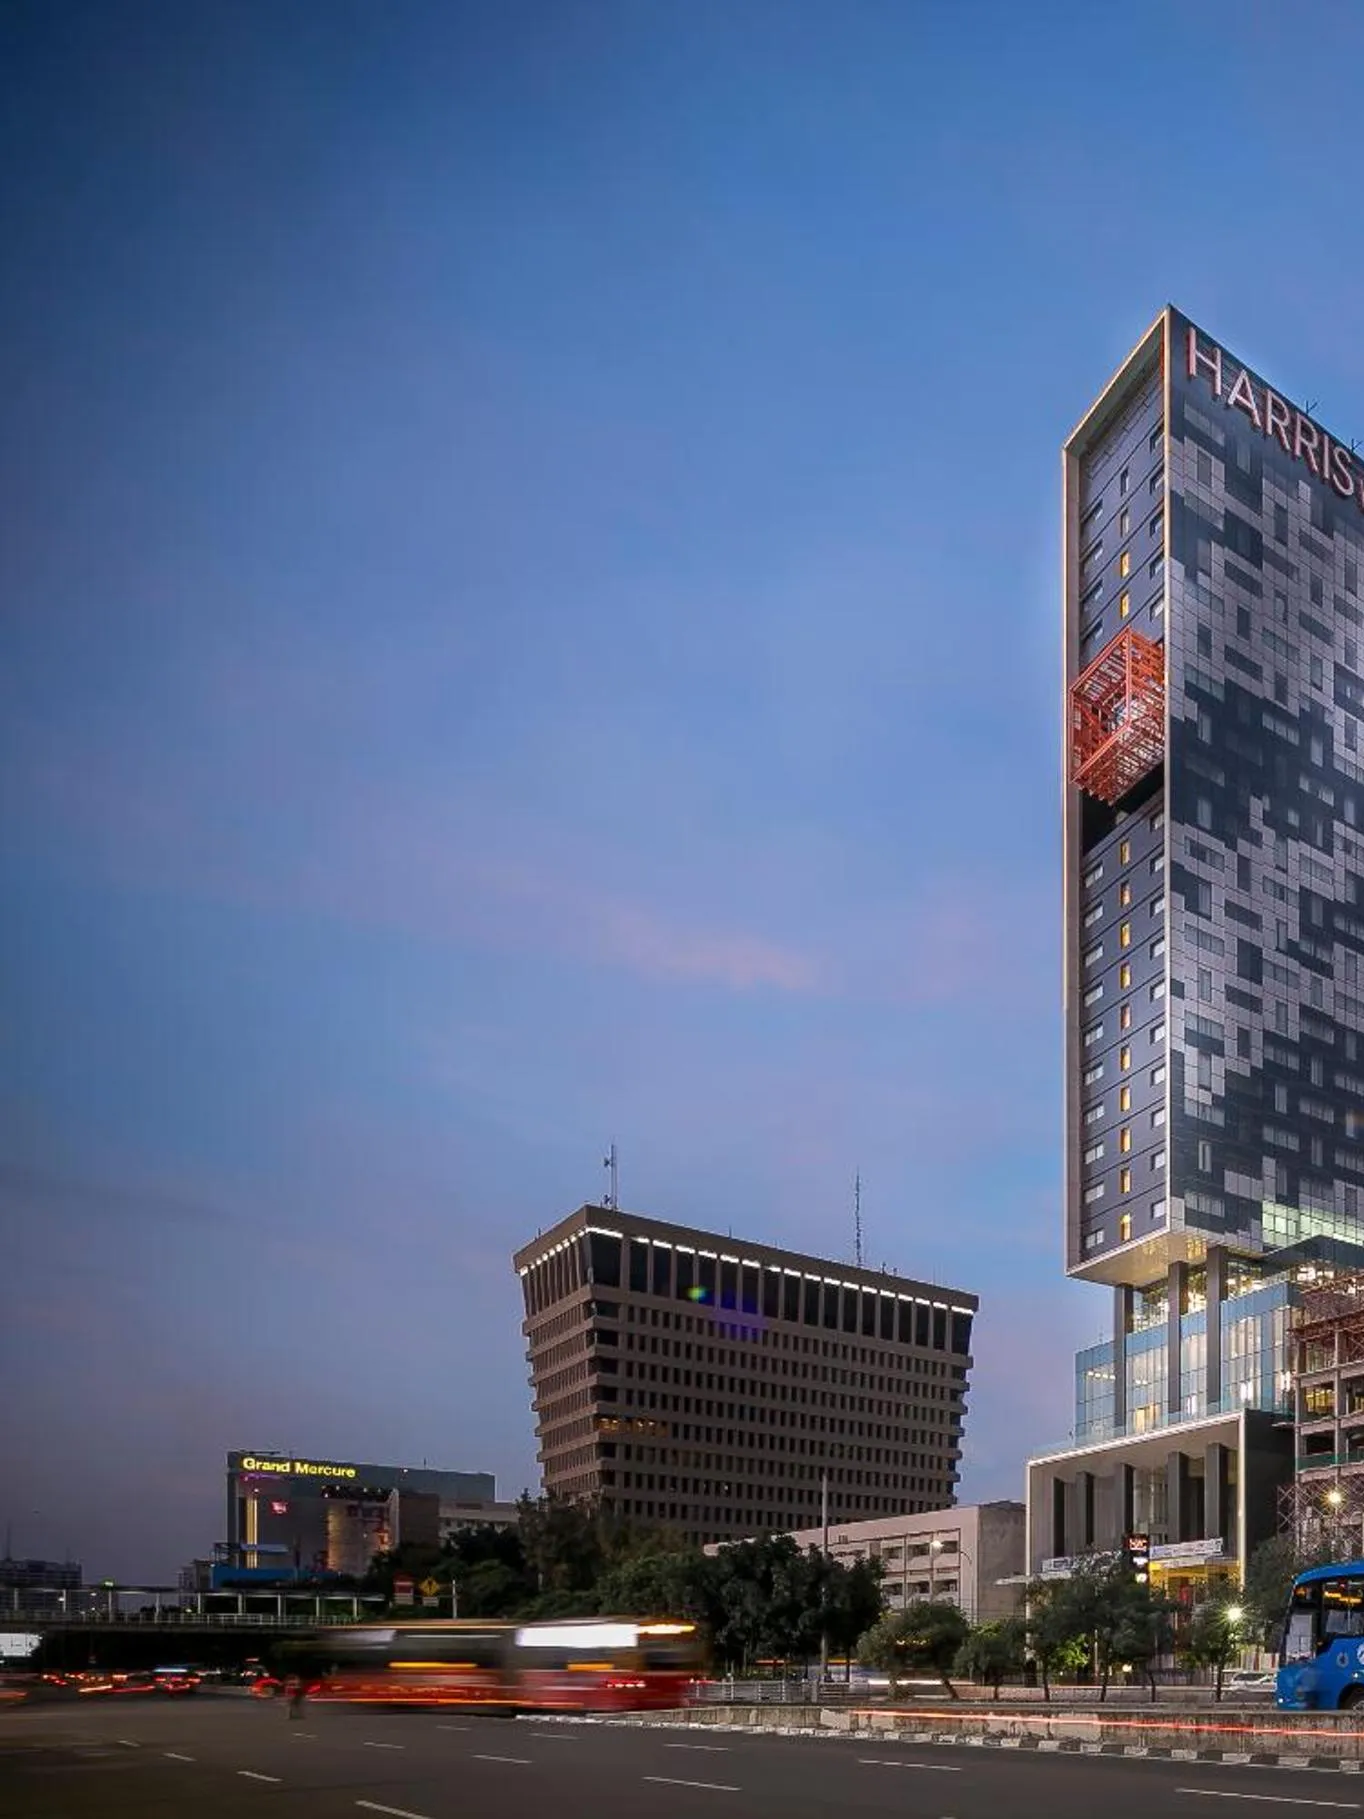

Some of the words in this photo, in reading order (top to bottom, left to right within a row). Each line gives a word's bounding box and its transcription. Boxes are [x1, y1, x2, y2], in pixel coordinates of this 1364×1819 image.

[1186, 327, 1355, 496] HARRIS
[243, 1457, 290, 1473] Grand
[295, 1461, 356, 1478] Mercure
